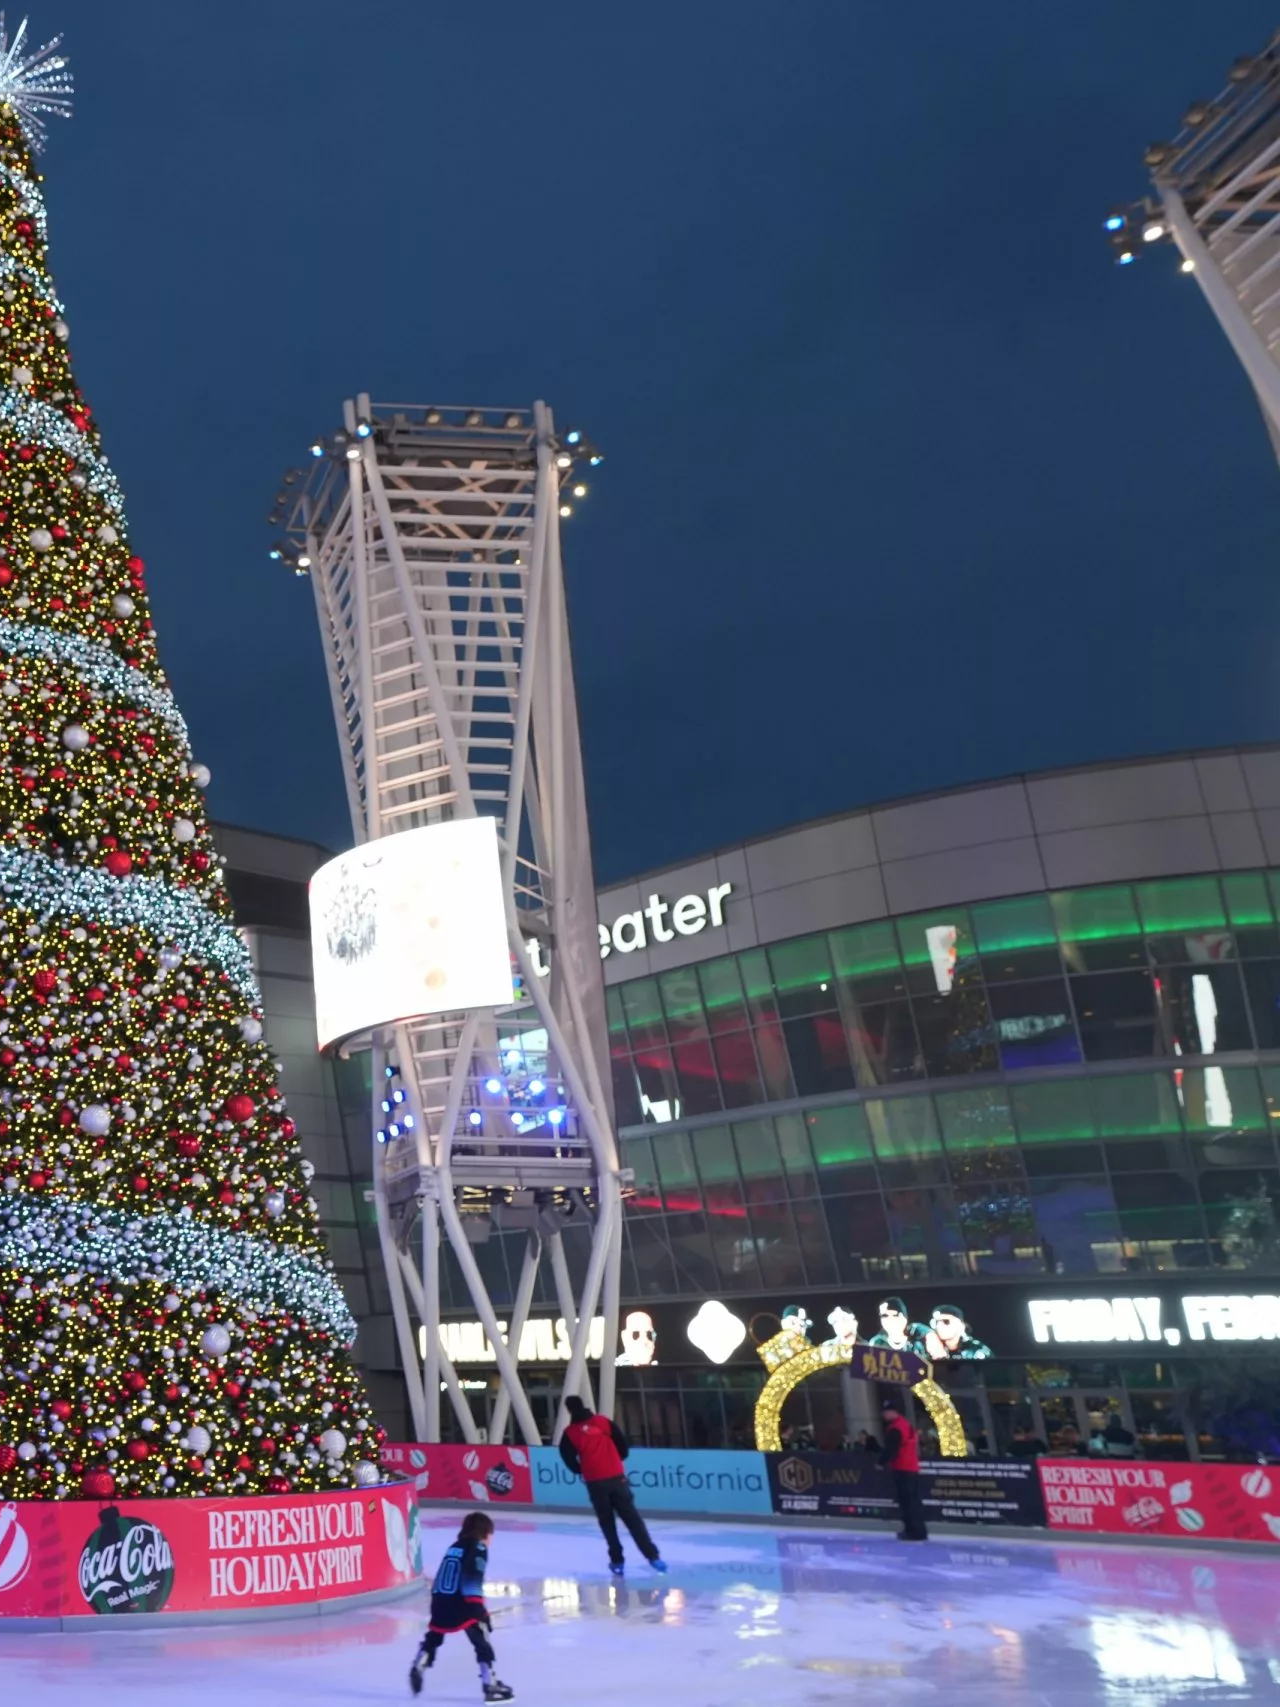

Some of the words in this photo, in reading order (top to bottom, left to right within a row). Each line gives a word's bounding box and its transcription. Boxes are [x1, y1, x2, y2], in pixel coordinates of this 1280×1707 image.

[879, 1350, 903, 1369] LA
[378, 1448, 404, 1462] OUR
[537, 1462, 584, 1485] blu
[628, 1465, 764, 1491] california
[817, 1467, 861, 1484] LAW
[1041, 1465, 1114, 1487] REFRESH
[1113, 1468, 1167, 1489] YOUR
[1044, 1485, 1116, 1507] HOLIDAY
[208, 1507, 316, 1550] REFRESH
[315, 1501, 366, 1542] YOUR
[1048, 1506, 1095, 1526] SPIRIT
[78, 1525, 175, 1603] Coca-Cola
[209, 1551, 317, 1597] HOLIDAY
[317, 1545, 363, 1587] SPIRIT
[106, 1591, 130, 1608] Real
[128, 1580, 161, 1599] Magic
